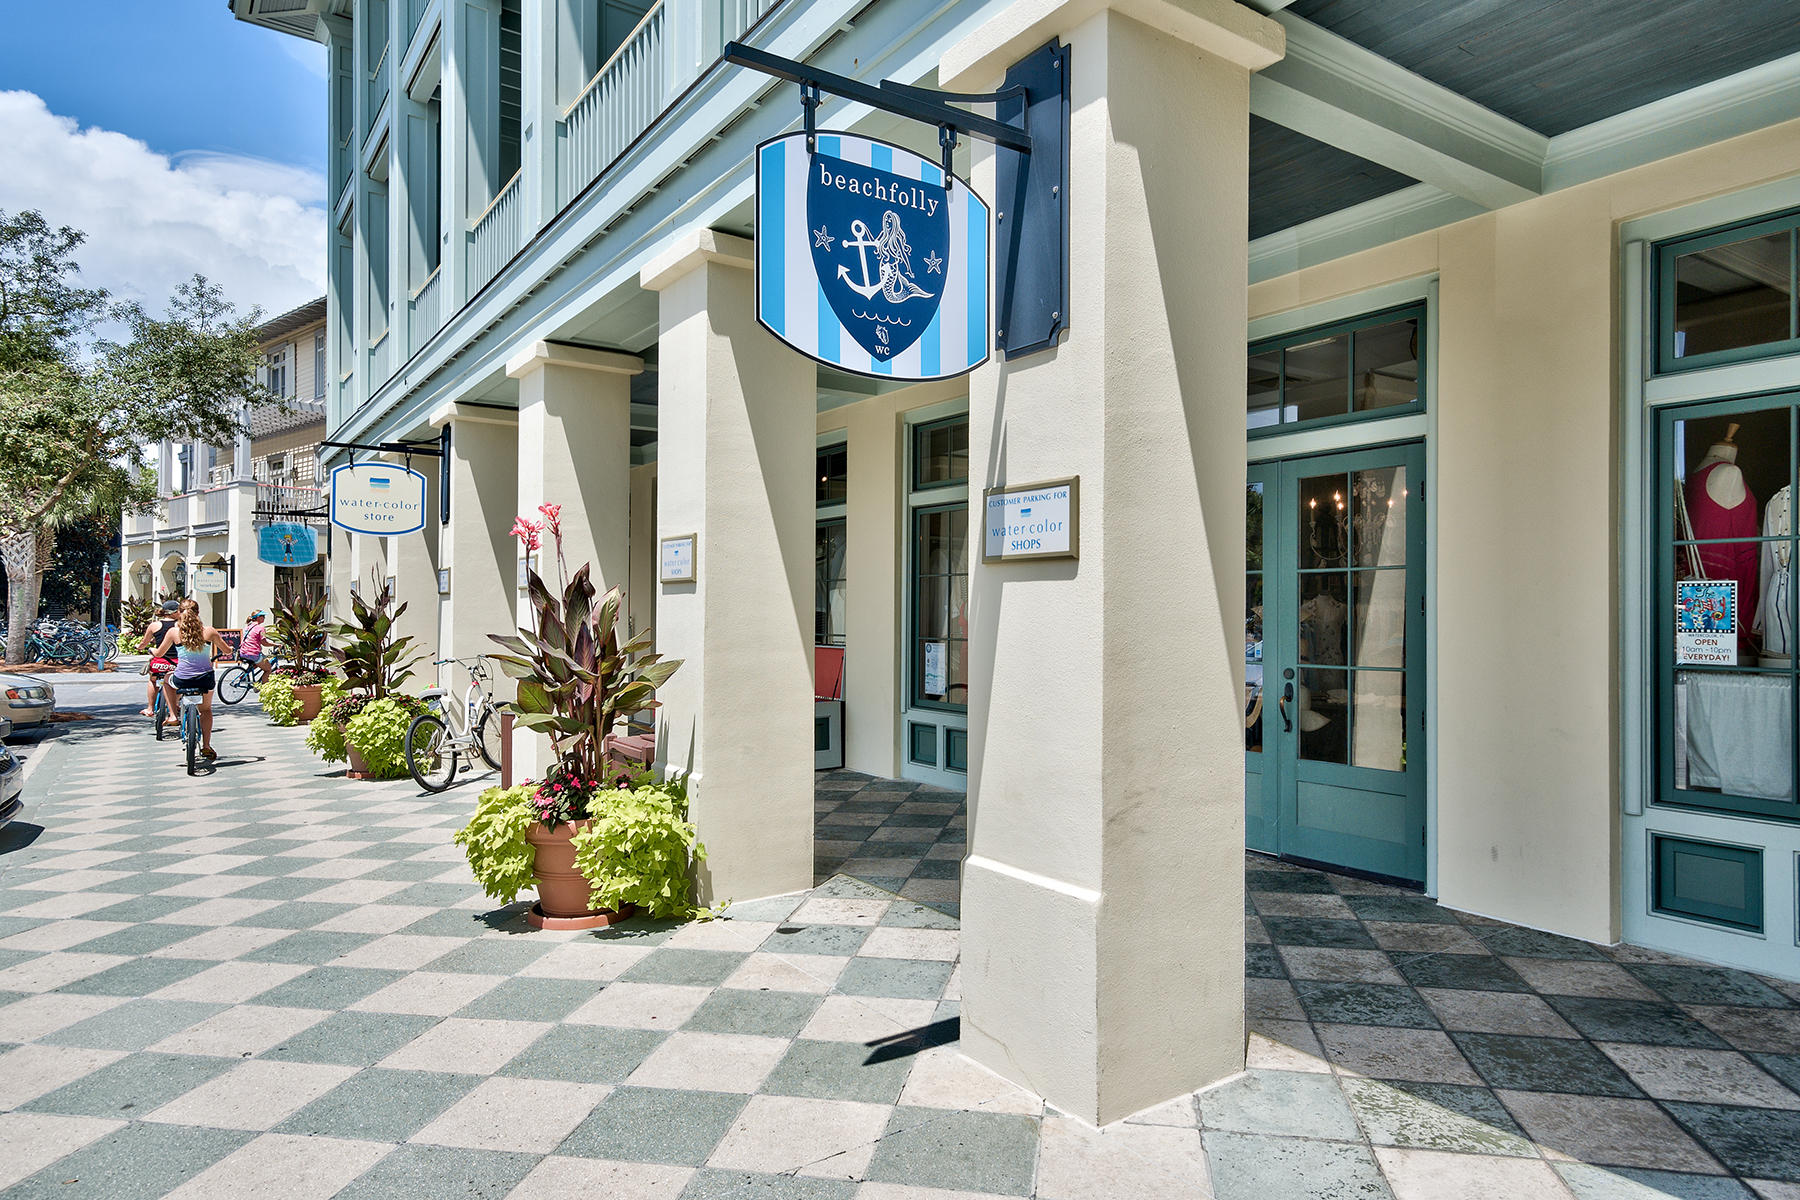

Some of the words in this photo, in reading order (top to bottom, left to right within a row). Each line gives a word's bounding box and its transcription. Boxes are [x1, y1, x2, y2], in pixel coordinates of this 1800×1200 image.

[820, 163, 939, 217] beachfolly
[988, 497, 1021, 508] CUSTOMER
[1023, 493, 1052, 503] PARKING
[1053, 491, 1068, 499] FOR
[364, 512, 395, 522] store
[1011, 538, 1041, 551] SHOPS
[1694, 638, 1718, 646] OPEN
[1683, 653, 1730, 661] EVERYDAY!
